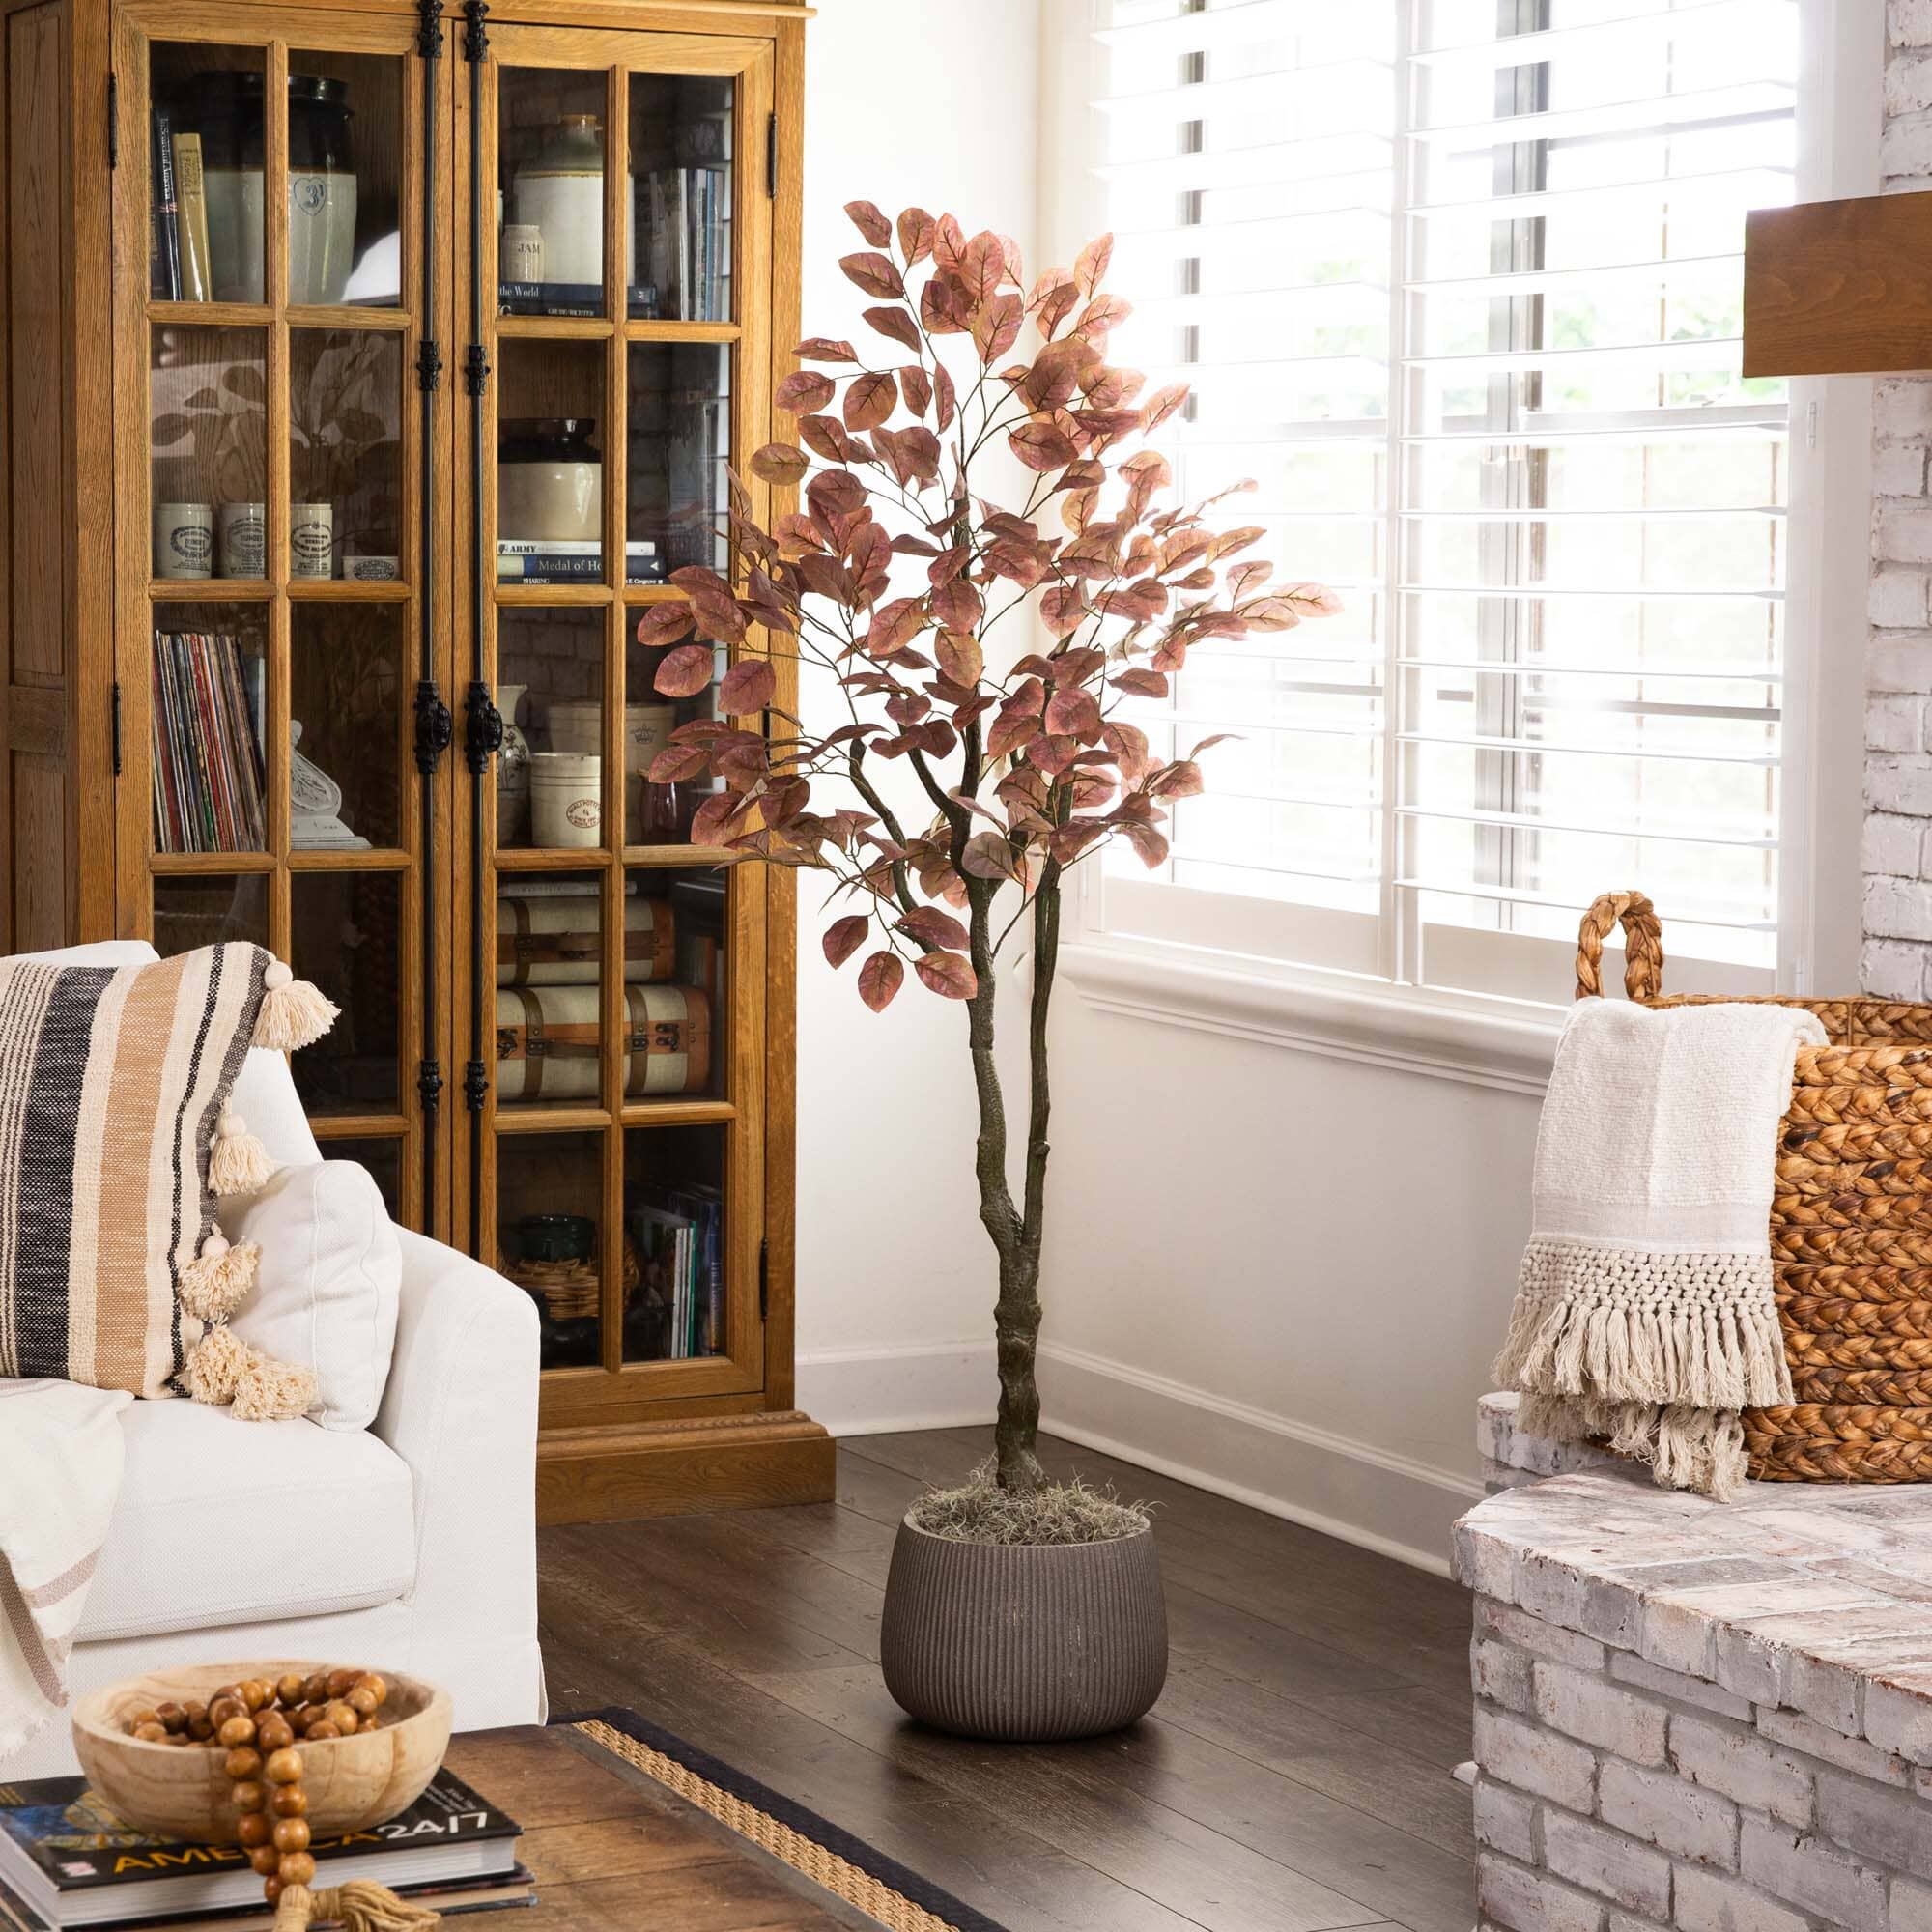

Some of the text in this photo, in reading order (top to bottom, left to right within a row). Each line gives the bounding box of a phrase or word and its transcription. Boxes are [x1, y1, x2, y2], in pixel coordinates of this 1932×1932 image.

[163, 164, 172, 200] America
[517, 243, 540, 255] JAM
[499, 285, 539, 298] the World
[509, 545, 537, 554] ARMY
[539, 559, 572, 572] Medal
[573, 559, 586, 572] of
[113, 1833, 382, 1874] AMEA
